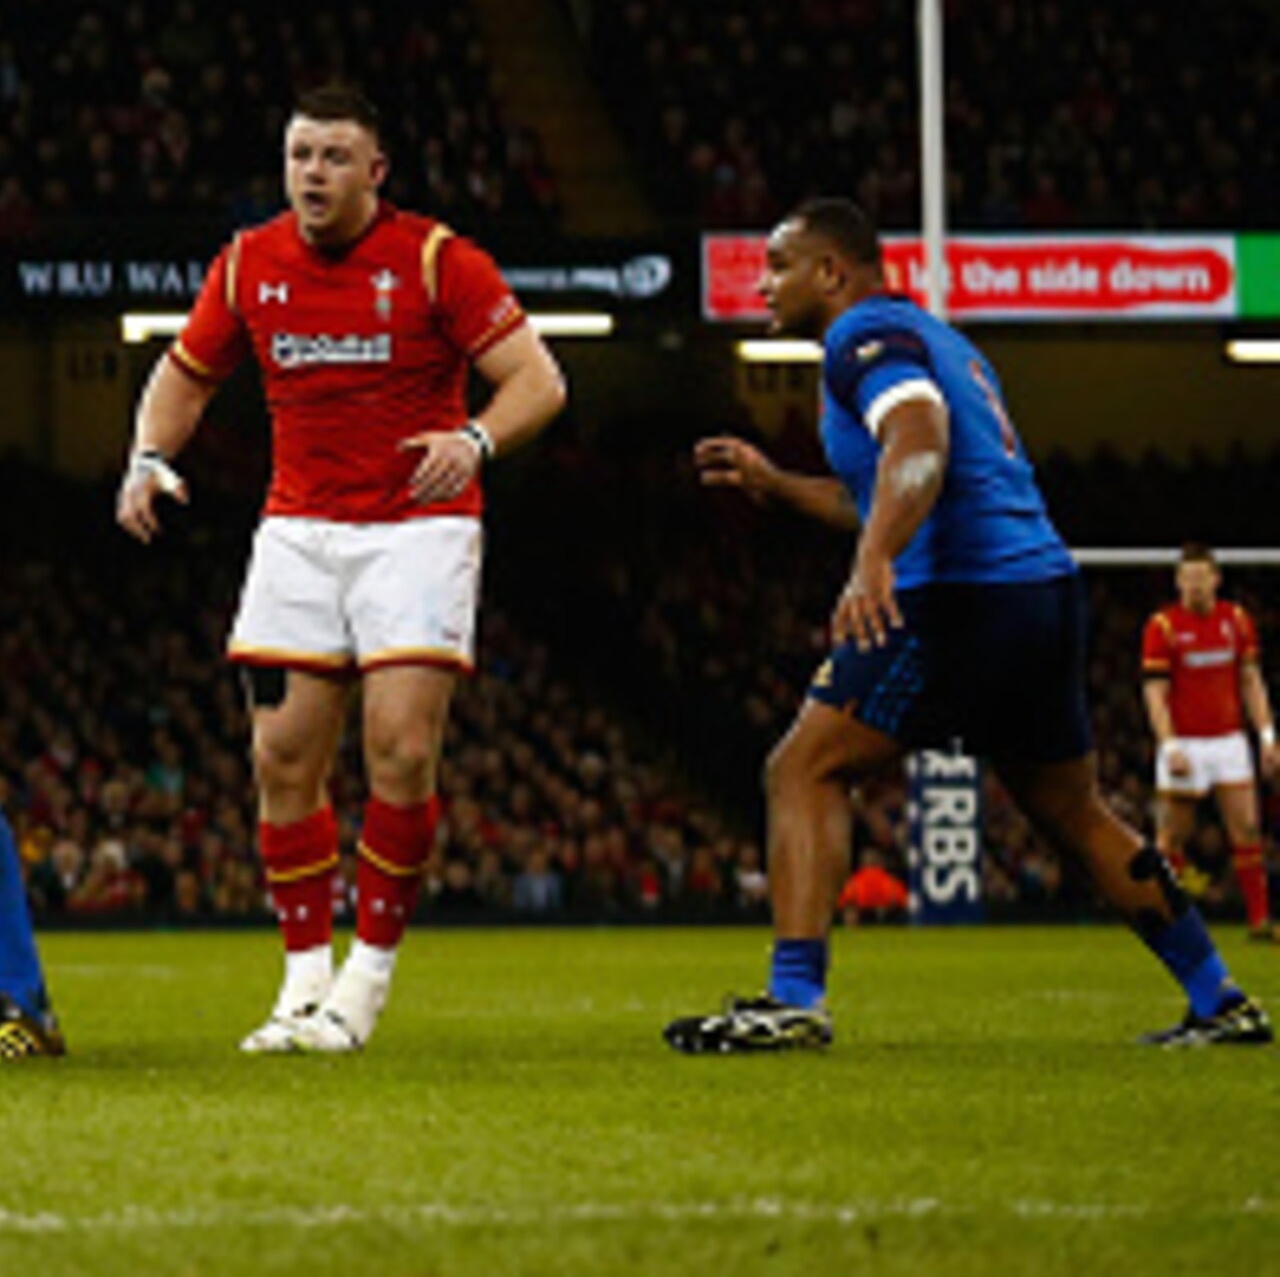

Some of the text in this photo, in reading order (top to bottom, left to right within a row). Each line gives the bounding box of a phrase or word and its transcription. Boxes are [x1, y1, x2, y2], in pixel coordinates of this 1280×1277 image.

[124, 260, 206, 296] WAL
[960, 256, 1020, 295] the
[1028, 256, 1100, 294] side
[1110, 256, 1211, 295] down
[921, 789, 978, 905] RBS
